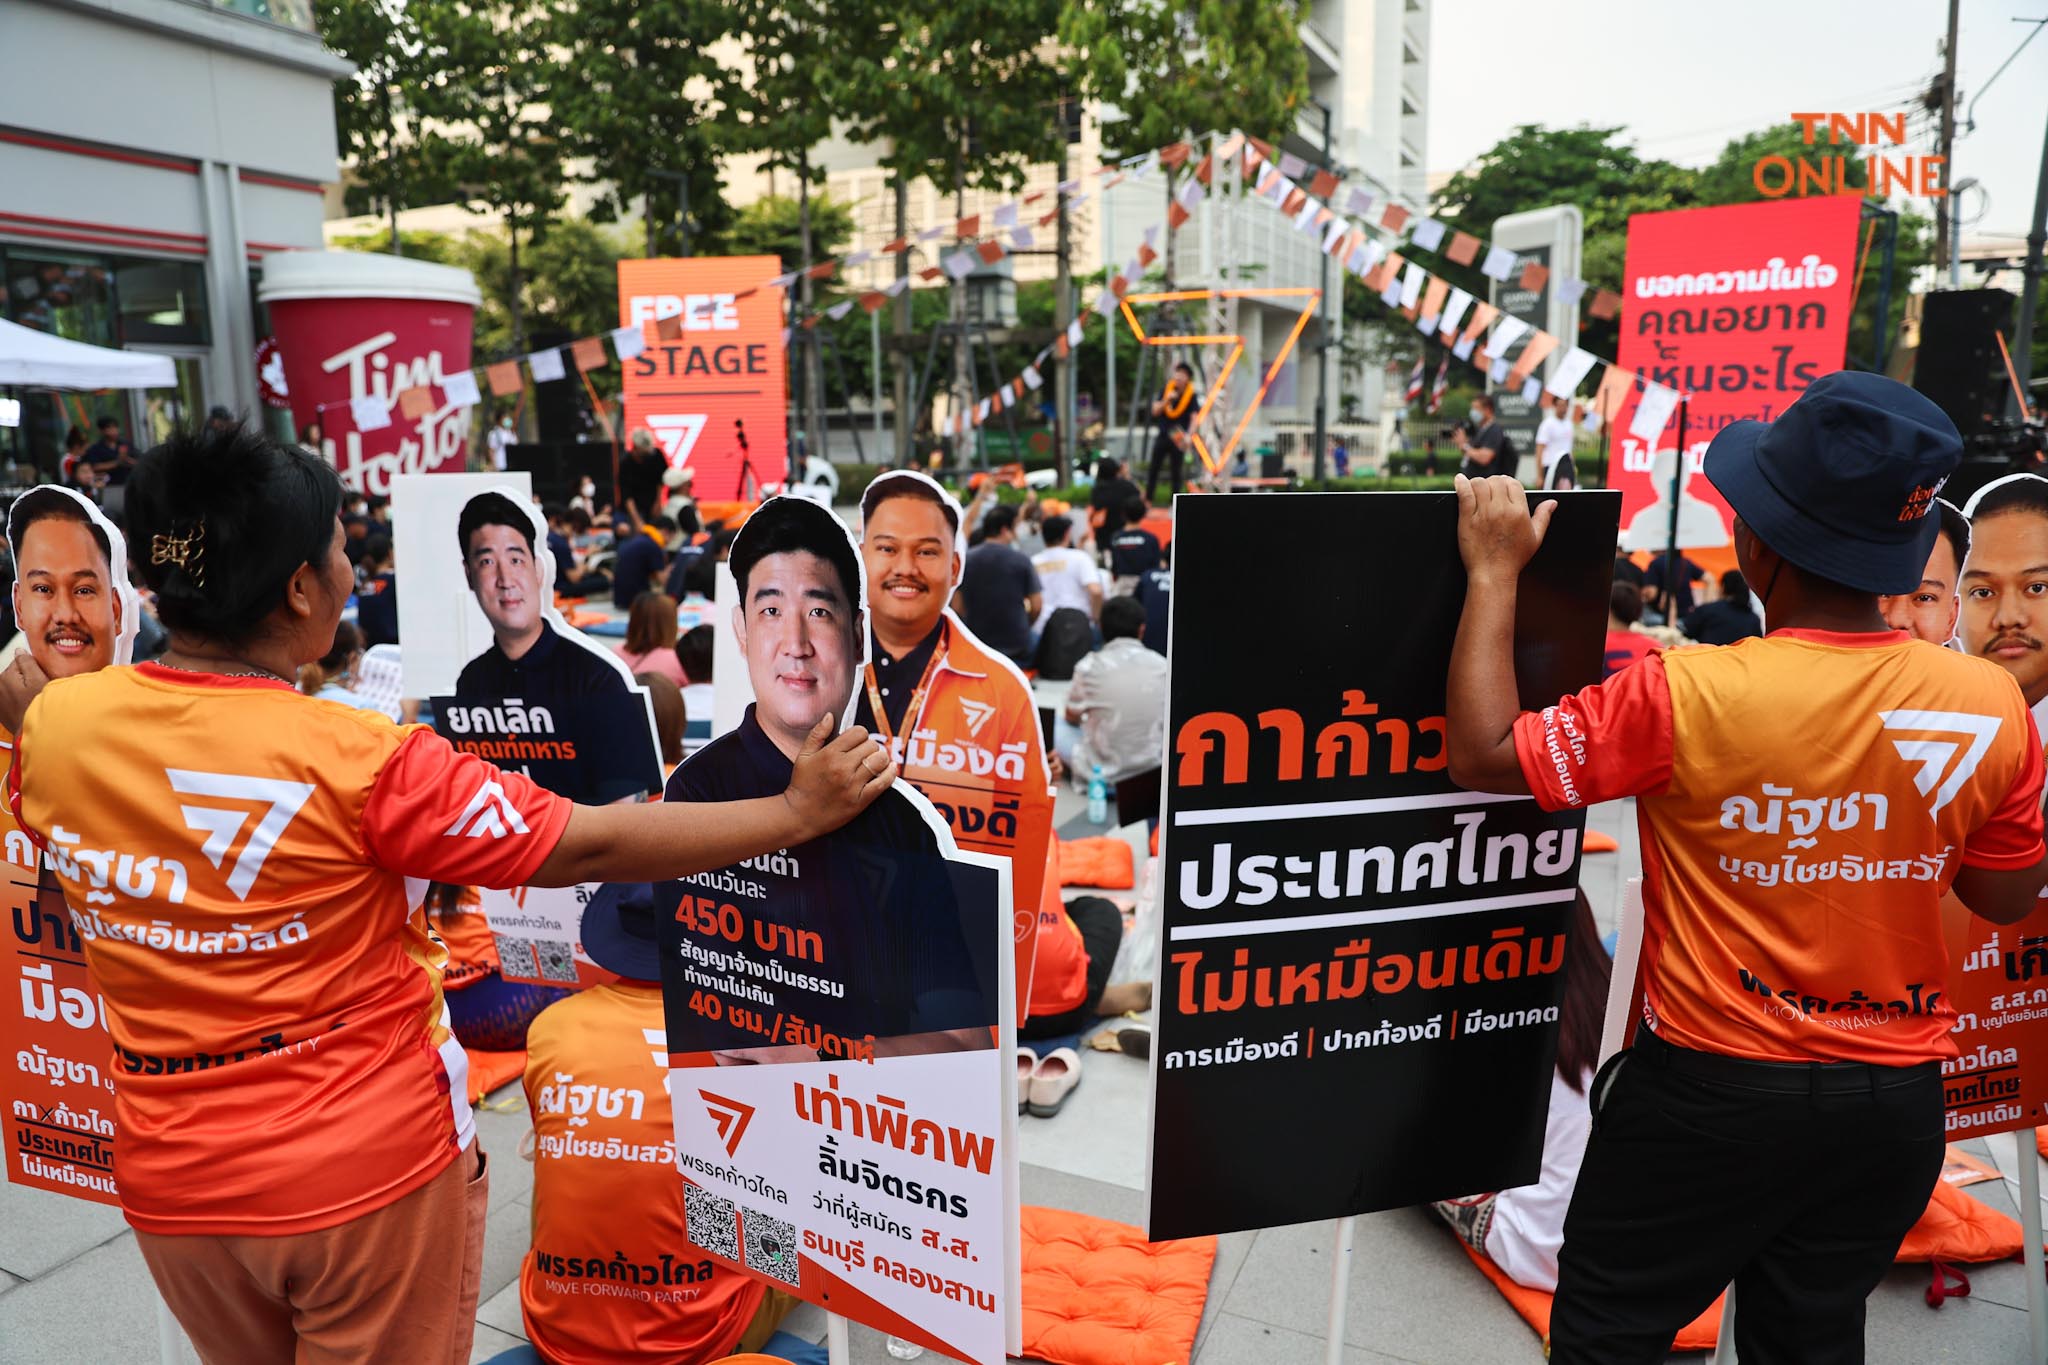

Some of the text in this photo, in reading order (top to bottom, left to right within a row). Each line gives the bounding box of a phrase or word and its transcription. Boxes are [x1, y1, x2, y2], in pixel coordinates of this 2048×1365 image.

[1636, 255, 1838, 298] บอกความในใจ
[630, 294, 740, 331] FREE
[322, 332, 444, 412] Tim
[635, 344, 767, 376] STAGE
[447, 698, 555, 733] ยกเลิก
[1719, 783, 1889, 849] ณัฐชา
[1180, 812, 1578, 909] ประเทศไทย
[489, 914, 562, 931] พรรคก้าวไกล
[674, 894, 823, 963] 450 บาท
[680, 937, 844, 999] สัญญาจ้างเป็นธรรม
[685, 966, 774, 1006] ทำงานไม่เกิน
[1171, 927, 1567, 1014] ไม่เหมือนเดิม
[688, 990, 722, 1020] 40
[1165, 1005, 1560, 1069] การเมืองดี ปากท้องดี มีอนาคต
[17, 1044, 99, 1087] ณัฐชา
[54, 1102, 117, 1136] ก้าวไก
[540, 1072, 645, 1127] ณัฐชา
[794, 1073, 995, 1175] เท่าพิภพ
[17, 1128, 113, 1165] ประเทศไท
[681, 1152, 788, 1205] พรรคก้าวไกล
[818, 1134, 969, 1219] ลิ้มจิตรกร
[812, 1190, 978, 1262] ว่าที่ผู้สมัคร ส.ส.
[537, 1250, 713, 1286] พรรคก้าวไกล
[545, 1280, 700, 1303] MOVE FORWARD PARTY
[803, 1229, 996, 1313] ธนบุรี คลองสาน
